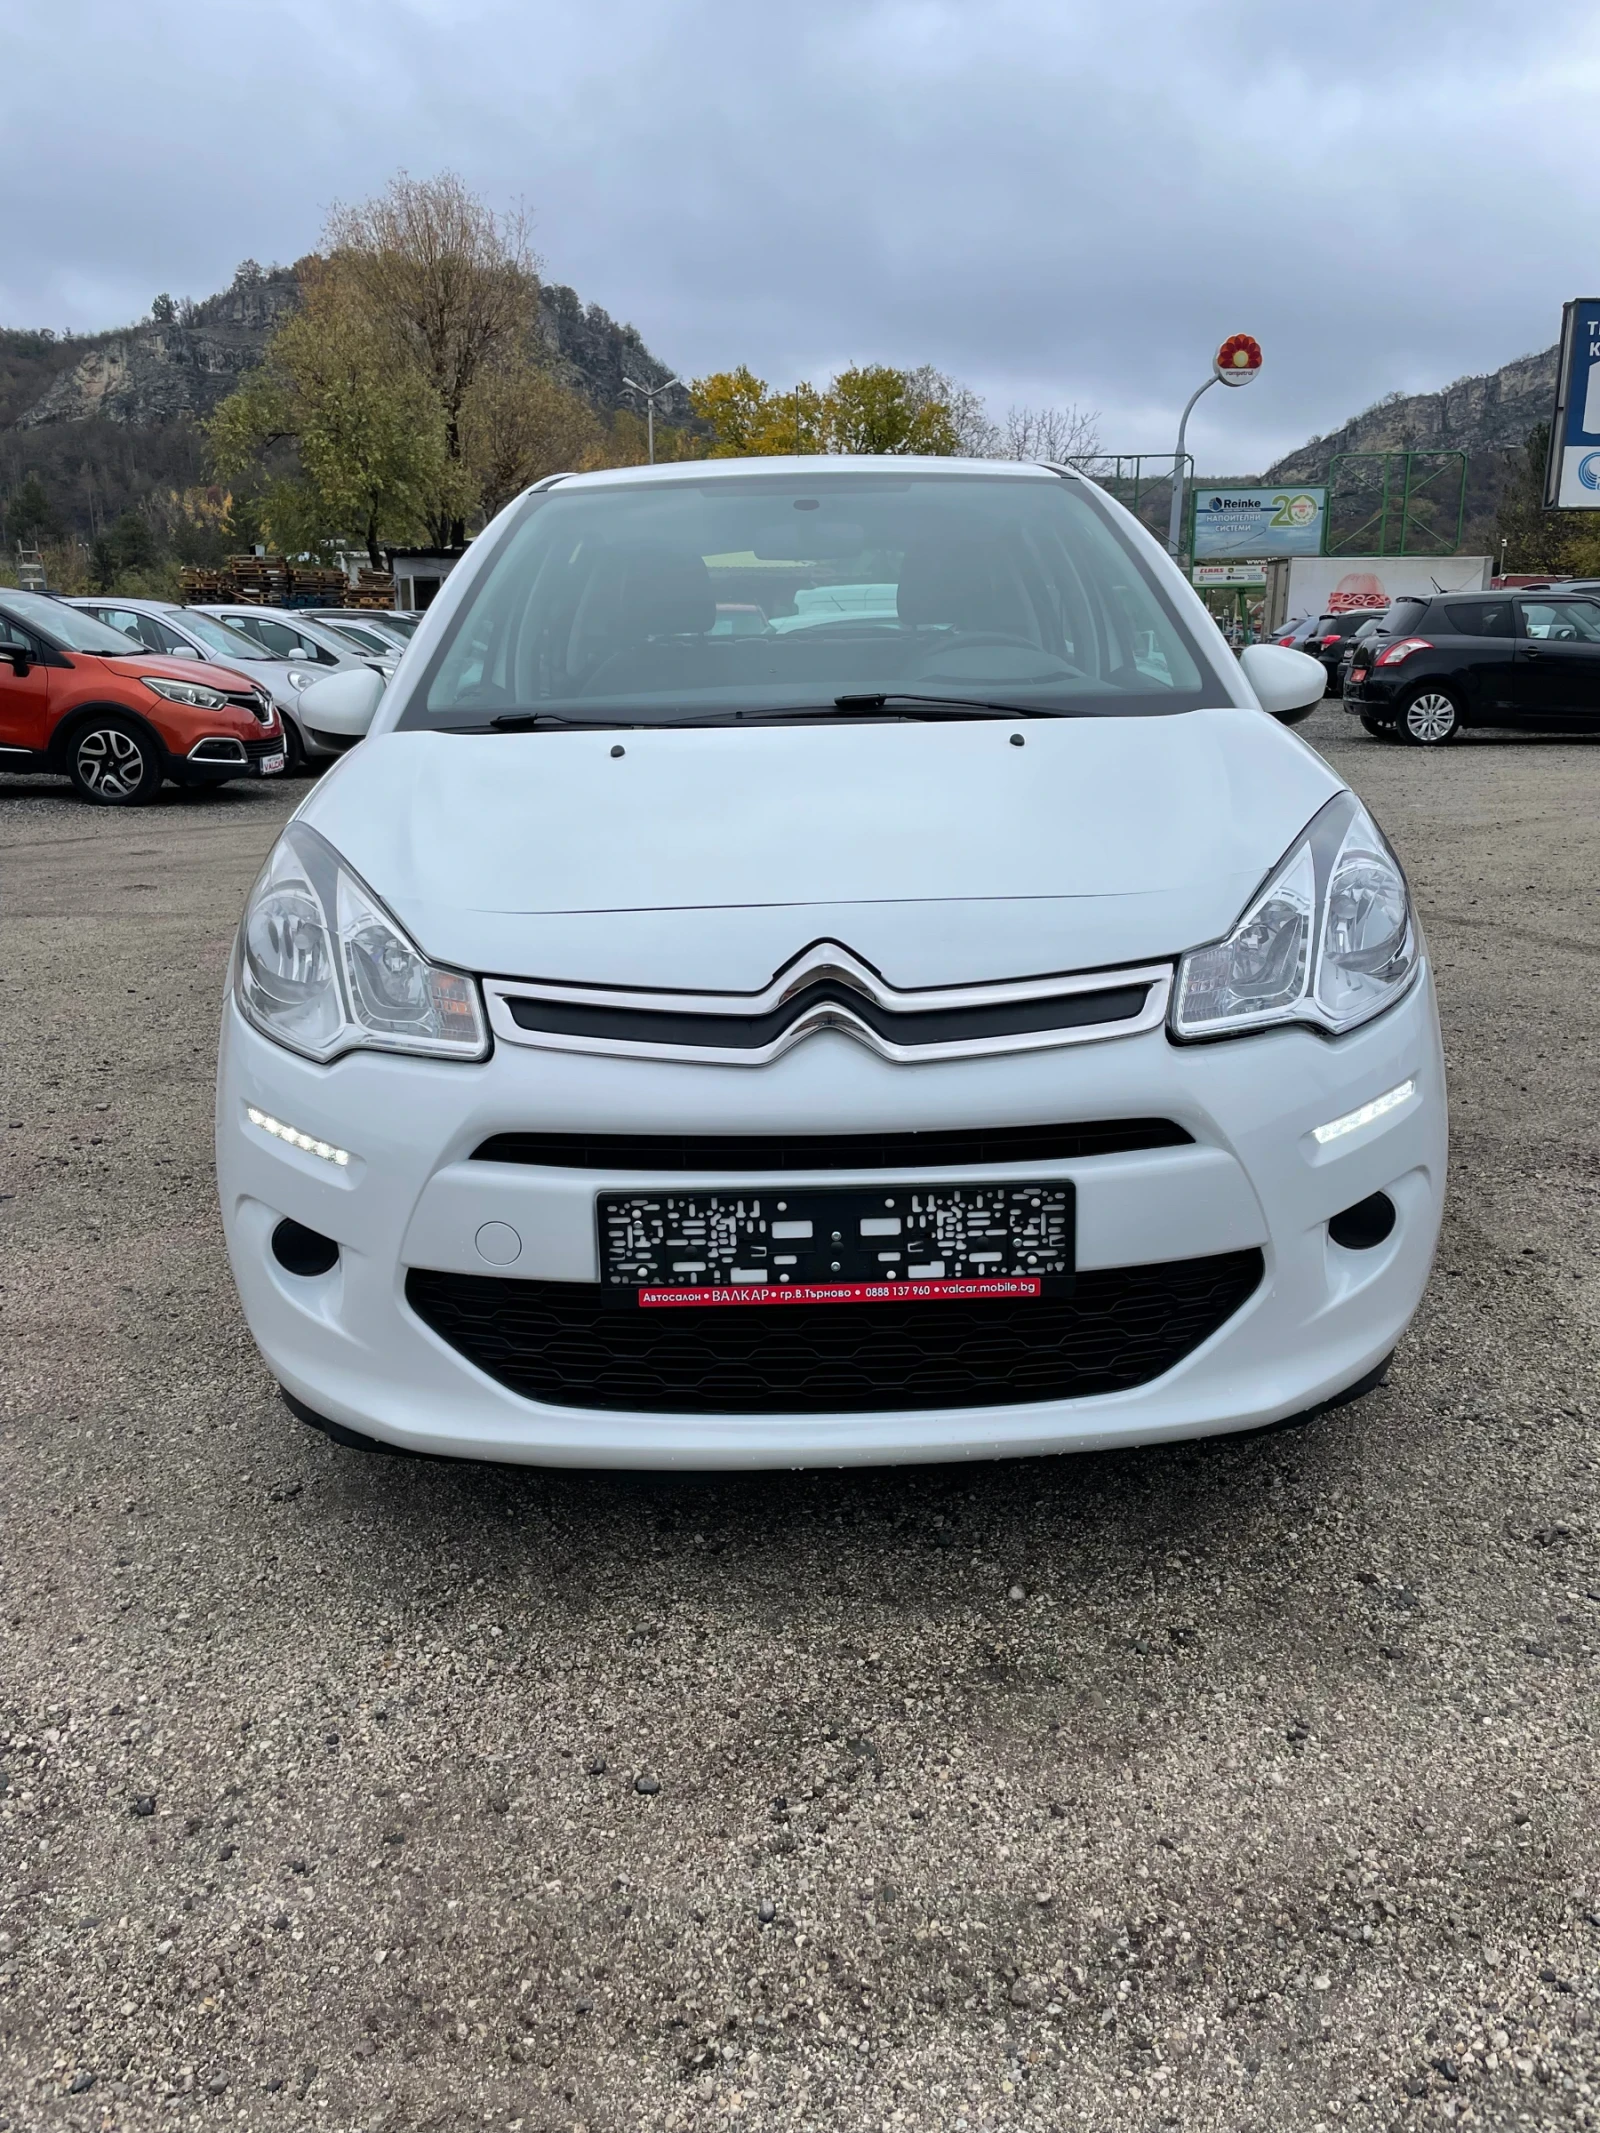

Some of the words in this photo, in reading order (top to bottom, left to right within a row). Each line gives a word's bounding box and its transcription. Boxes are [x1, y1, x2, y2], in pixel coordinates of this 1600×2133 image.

[1223, 499, 1262, 508] Reinke
[1206, 514, 1261, 522] НАПОИТЕЛНИ
[643, 1293, 701, 1302] Автосалон
[712, 1290, 769, 1302] ВАЛКАР
[865, 1287, 890, 1298] 0888
[893, 1286, 909, 1296] 137
[912, 1285, 931, 1296] 960
[942, 1282, 1036, 1294] valcar.mobile.bg
